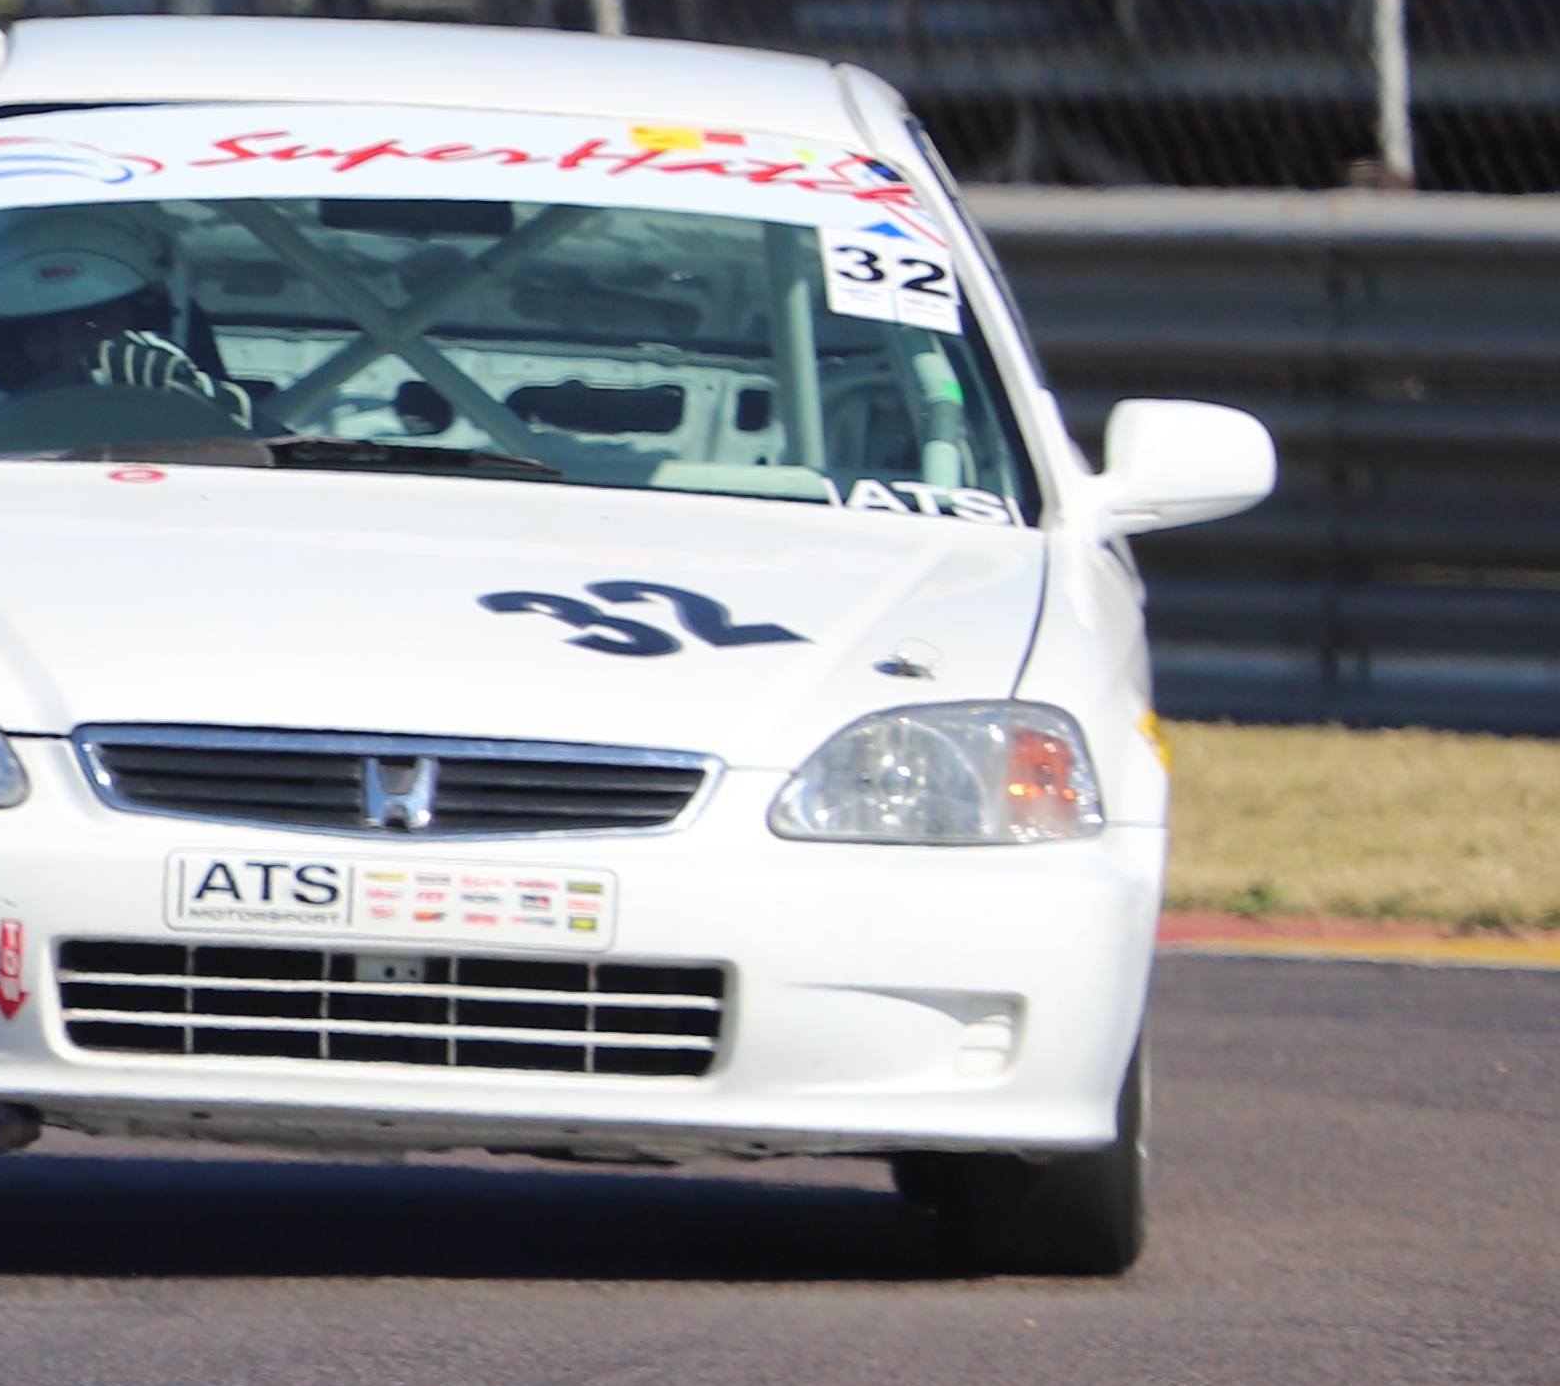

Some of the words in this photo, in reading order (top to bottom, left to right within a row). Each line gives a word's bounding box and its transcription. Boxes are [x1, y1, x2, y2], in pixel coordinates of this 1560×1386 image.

[832, 245, 952, 300] 32
[845, 477, 1016, 525] ATS
[474, 579, 818, 658] 32
[192, 859, 340, 906] ATS
[189, 906, 342, 925] MOTORSPORT
